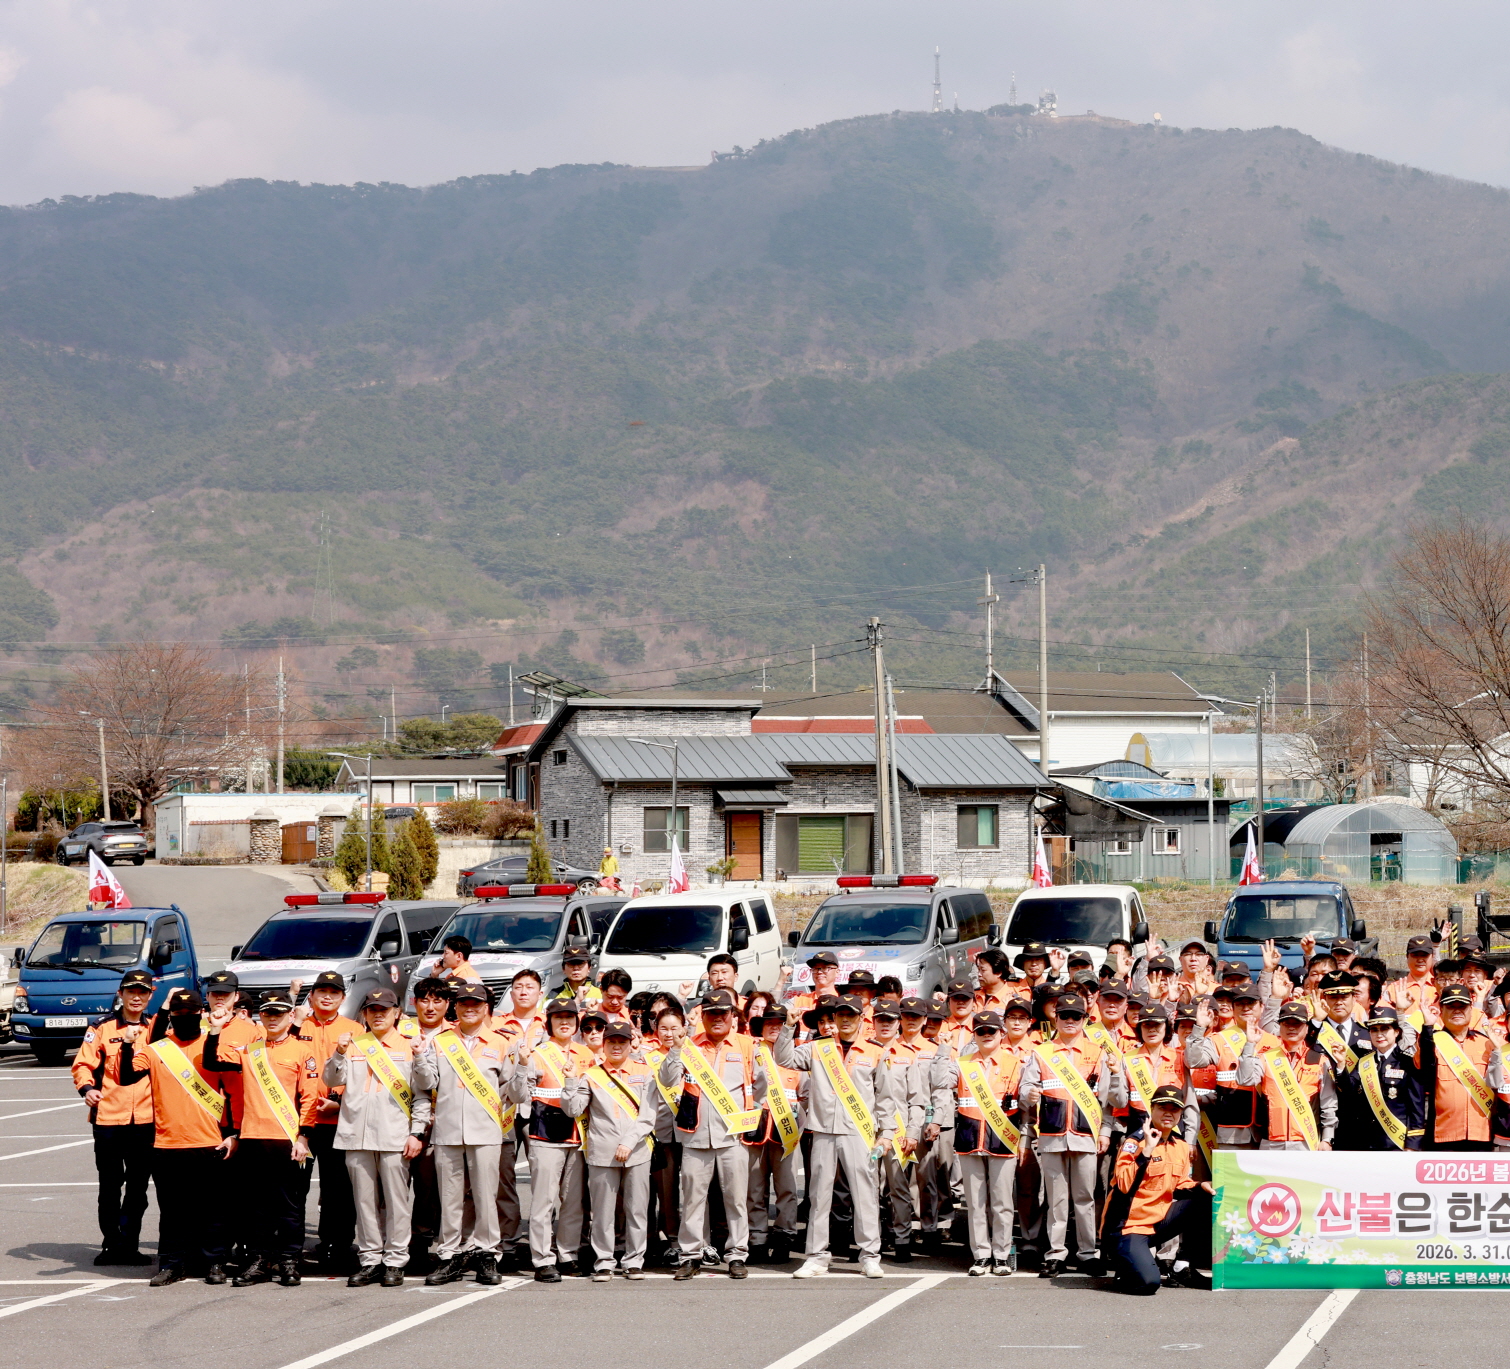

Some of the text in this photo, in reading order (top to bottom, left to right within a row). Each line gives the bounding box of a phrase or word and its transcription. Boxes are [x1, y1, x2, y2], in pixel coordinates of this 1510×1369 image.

[66, 1018, 84, 1026] 7537
[191, 1082, 214, 1104] 불씨는
[256, 1060, 271, 1085] 불씨는
[268, 1087, 283, 1104] 잠깐
[376, 1058, 402, 1089] 산불조심
[456, 1058, 475, 1080] 불씨는
[472, 1081, 488, 1097] 잠깐
[700, 1071, 722, 1096] 예방이
[718, 1098, 734, 1114] 먼저
[1060, 1066, 1082, 1090] 불씨는
[1078, 1090, 1093, 1108] 잠깐
[1136, 1069, 1152, 1096] 불씨는
[1278, 1070, 1296, 1096] 불씨는
[1292, 1097, 1306, 1115] 잠깐
[1462, 1068, 1488, 1100] 산불조심
[770, 1088, 786, 1114] 예방이
[781, 1118, 794, 1136] 먼저
[828, 1058, 874, 1141] 산불조심 예방이 먼저
[976, 1086, 992, 1108] 불씨는
[988, 1110, 1004, 1128] 잠깐
[1366, 1074, 1380, 1108] 산불조심
[1379, 1108, 1399, 1134] 예방이
[1423, 1163, 1486, 1182] 2026년
[1317, 1192, 1432, 1232] 산불은
[1416, 1244, 1458, 1260] 2026.
[1463, 1244, 1476, 1260] 3.
[1405, 1272, 1450, 1284] 충청남도
